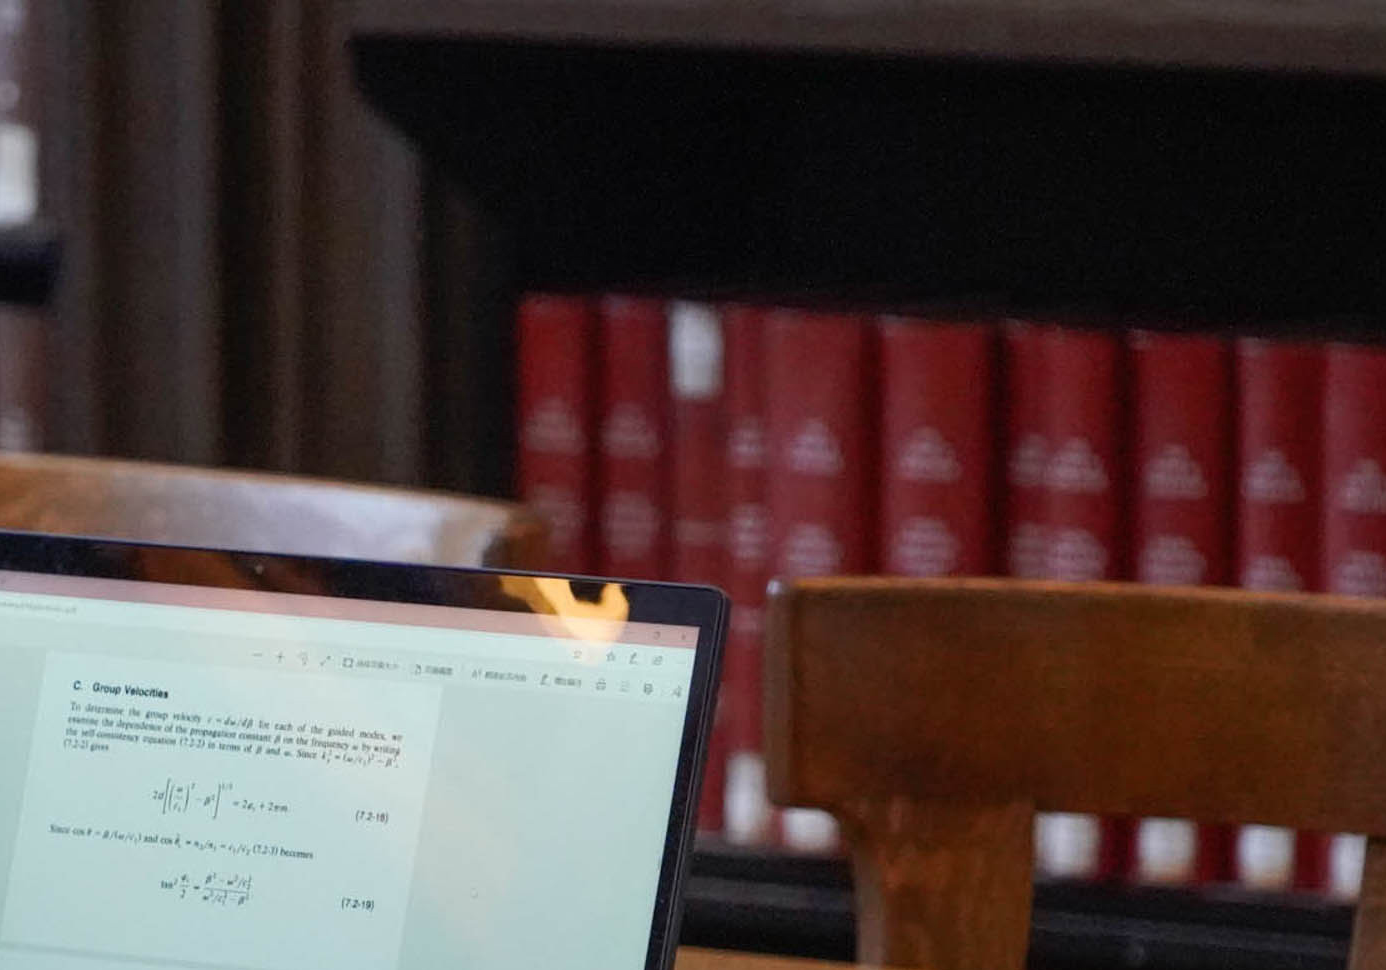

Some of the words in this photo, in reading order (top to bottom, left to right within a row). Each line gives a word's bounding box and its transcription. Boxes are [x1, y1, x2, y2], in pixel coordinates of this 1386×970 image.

[92, 682, 121, 696] Group
[124, 684, 169, 699] Velocities
[67, 716, 98, 726] examine
[102, 718, 113, 727] the
[116, 720, 163, 732] dependence
[164, 723, 174, 733] of
[175, 724, 187, 733] the
[189, 726, 235, 739] propagation
[238, 732, 271, 743] constant
[296, 736, 309, 746] the
[311, 738, 349, 750] frequency
[361, 743, 371, 752] by
[374, 745, 401, 757] writing
[70, 702, 81, 711] To
[85, 703, 124, 715] determine
[129, 707, 140, 717] the
[145, 710, 168, 720] group
[173, 711, 201, 724] velocity
[258, 719, 270, 729] for
[274, 721, 293, 731] each
[297, 723, 306, 733] of
[310, 725, 323, 735] the
[327, 726, 355, 738] guided
[66, 728, 78, 737] the
[142, 734, 177, 745] equation
[207, 740, 215, 749] in
[218, 741, 241, 752] terms
[243, 744, 252, 753] of
[266, 746, 281, 756] and
[296, 749, 317, 760] Since
[90, 743, 109, 752] gives
[49, 824, 70, 834] Since
[143, 835, 159, 843] and
[280, 846, 314, 860] becomes
